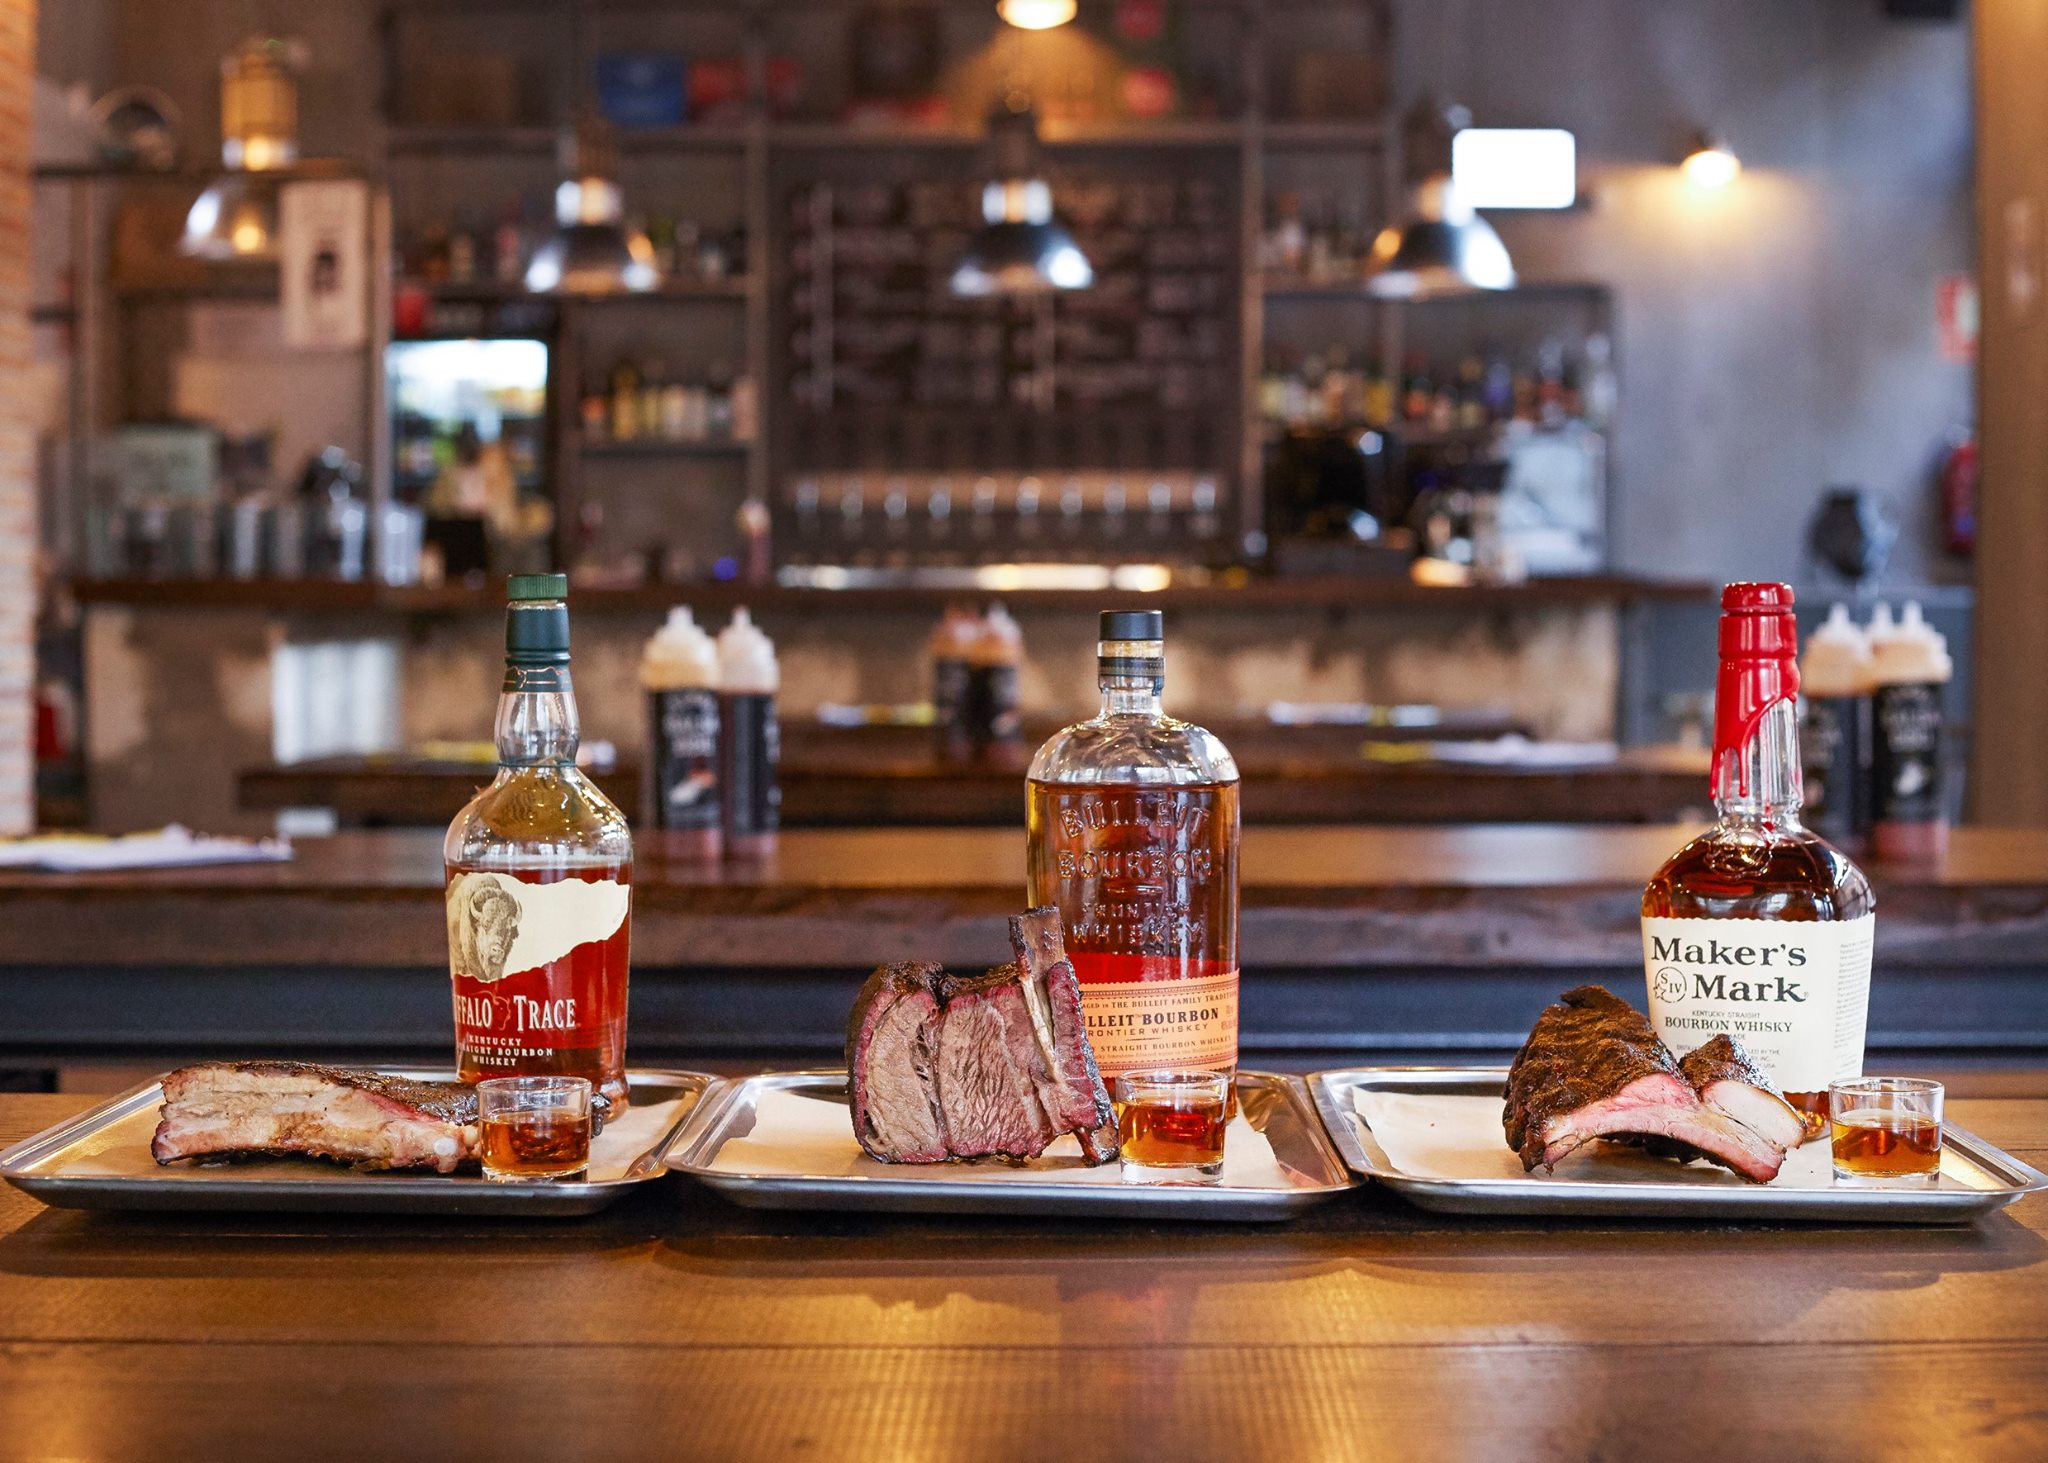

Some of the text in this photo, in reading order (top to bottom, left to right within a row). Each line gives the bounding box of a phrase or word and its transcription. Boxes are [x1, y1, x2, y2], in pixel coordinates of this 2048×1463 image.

[1058, 849, 1211, 878] BOURBON
[1651, 936, 1807, 967] Maker's
[1660, 973, 1669, 985] S
[1691, 973, 1807, 1003] Mark
[1172, 996, 1201, 1006] FAMILY
[455, 994, 576, 1032] FFALO TRACE
[1083, 1014, 1134, 1028] LLEIT
[1142, 1007, 1219, 1025] BOURBON
[1088, 1023, 1208, 1037] RONTIER WHISKEY
[1665, 1016, 1793, 1033] BOURBON WHISKY
[469, 1034, 522, 1047] KENTUCKY
[1100, 1044, 1148, 1053] STRAIGHT
[1152, 1040, 1196, 1050] BOURBON
[498, 1047, 553, 1057] BOURBON
[472, 1055, 517, 1067] WHISKEY
